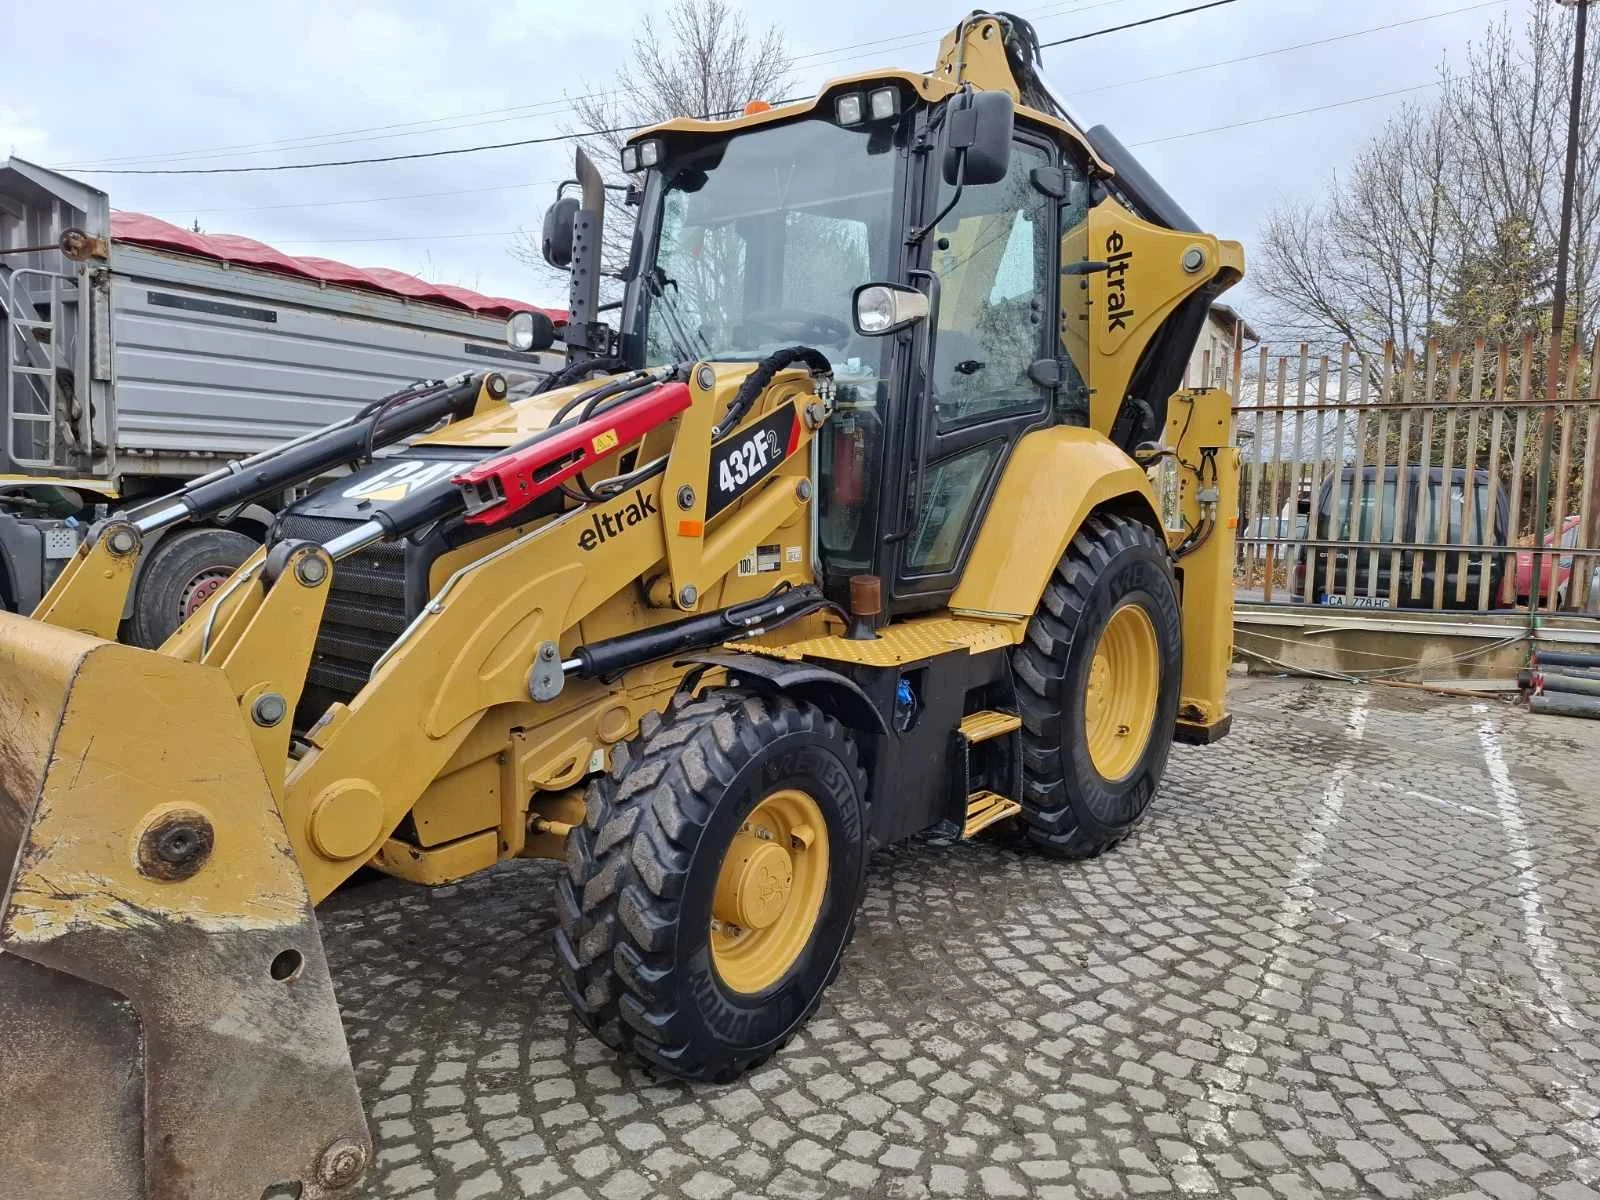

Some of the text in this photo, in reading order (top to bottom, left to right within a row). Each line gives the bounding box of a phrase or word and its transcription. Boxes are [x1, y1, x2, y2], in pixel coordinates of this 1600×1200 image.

[1106, 230, 1134, 335] eltrak
[577, 489, 658, 552] eltrak
[739, 558, 751, 574] 100
[1329, 595, 1343, 607] CA
